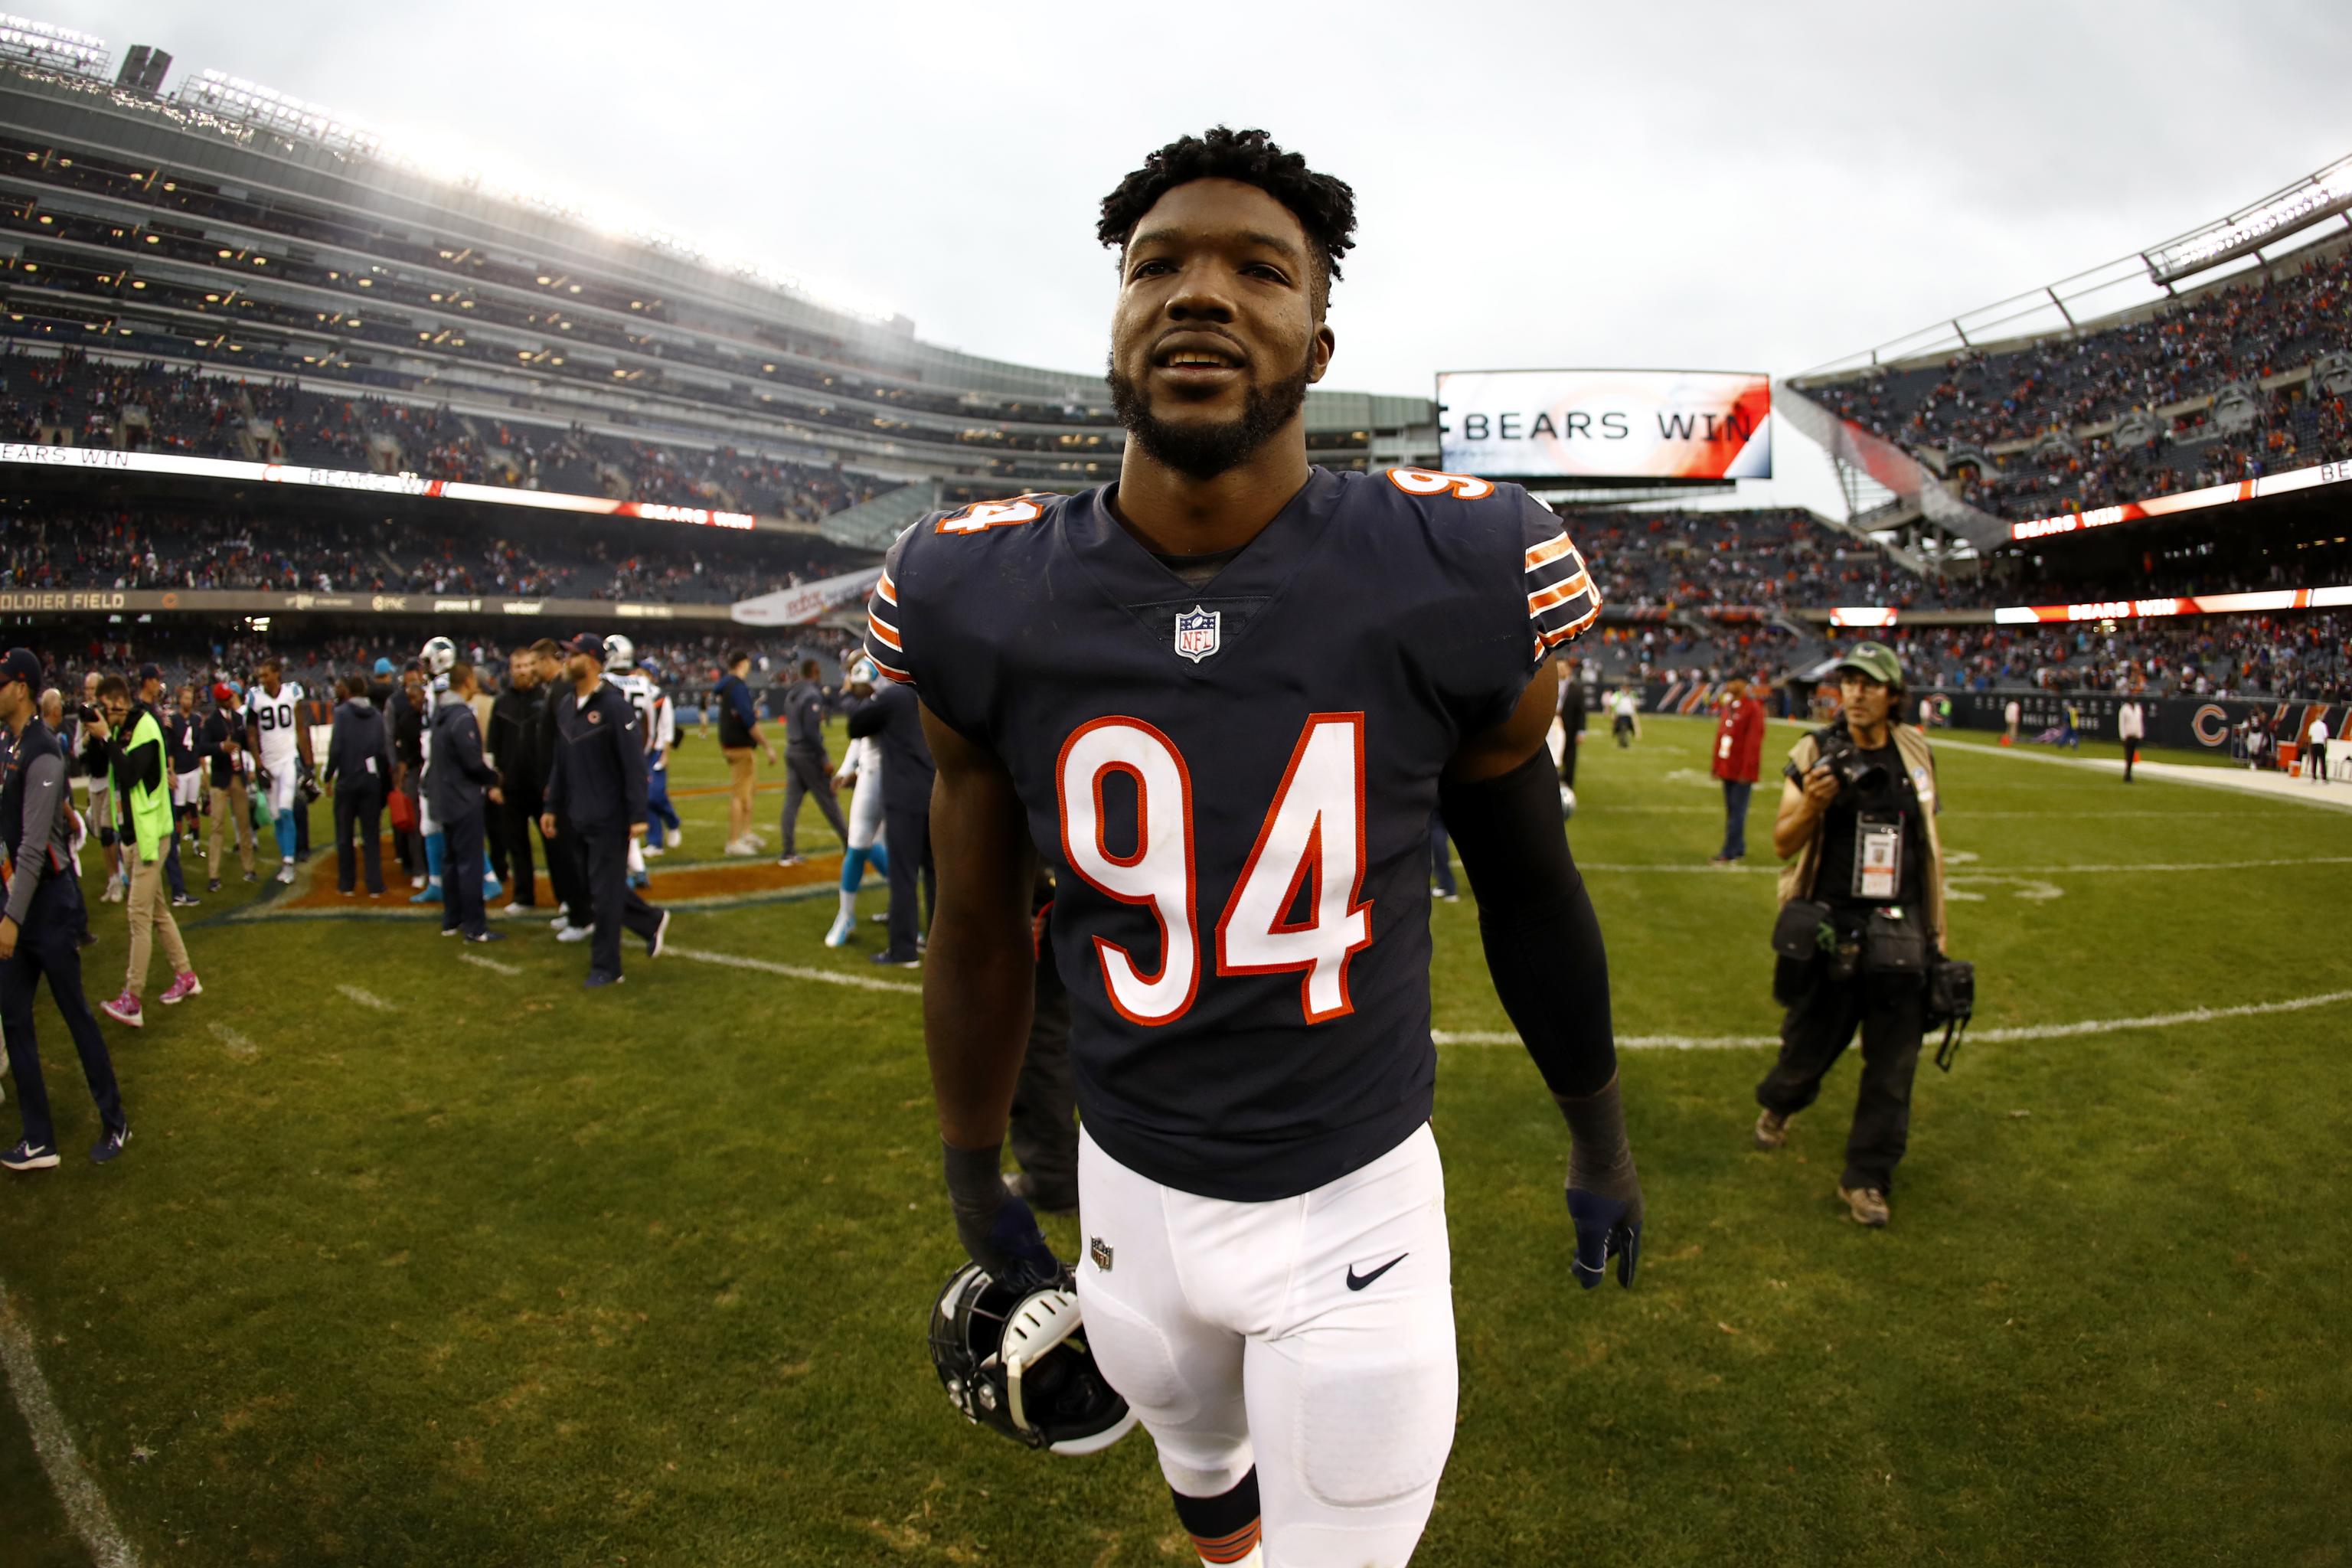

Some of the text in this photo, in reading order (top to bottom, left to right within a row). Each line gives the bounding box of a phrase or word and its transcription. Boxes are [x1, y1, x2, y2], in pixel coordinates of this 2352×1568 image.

[1465, 411, 1751, 443] BEARS WIN
[81, 448, 129, 466] WIN
[640, 502, 753, 530] BEARS WIN
[2014, 505, 2123, 540] BEARS WIN
[72, 593, 125, 609] FIELD
[2068, 598, 2177, 621] BEARS WIN
[1182, 631, 1211, 652] NFL
[261, 704, 292, 730] 90
[182, 725, 194, 752] 4
[1057, 710, 1374, 1027] 94
